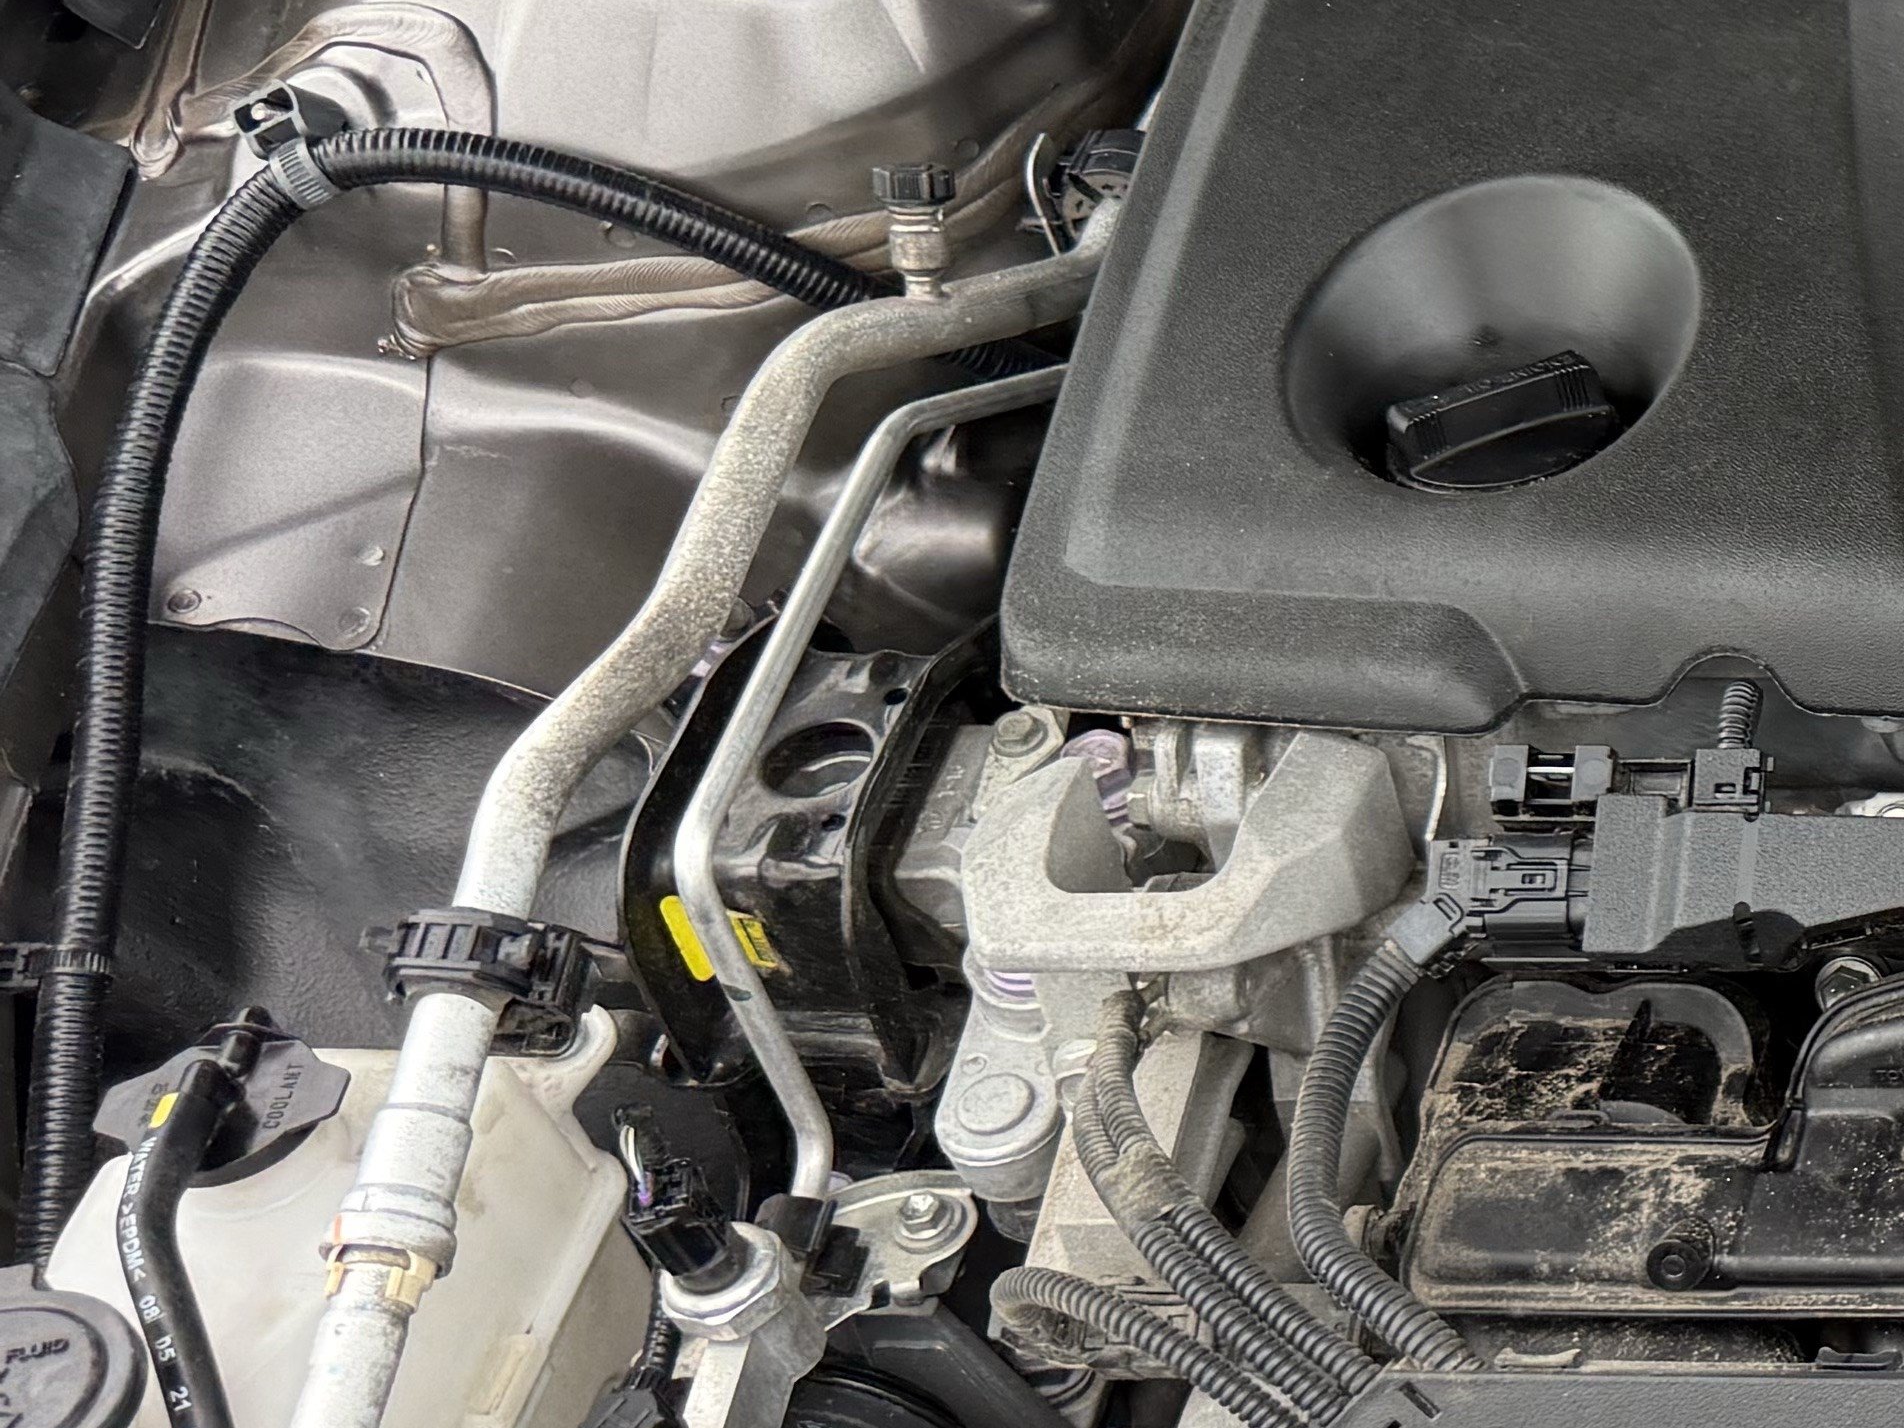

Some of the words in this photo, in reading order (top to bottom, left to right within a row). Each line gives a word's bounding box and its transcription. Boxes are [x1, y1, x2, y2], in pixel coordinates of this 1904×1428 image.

[262, 1063, 304, 1130] COOLANT
[124, 1136, 157, 1199] WATER
[169, 1386, 192, 1413] 21
